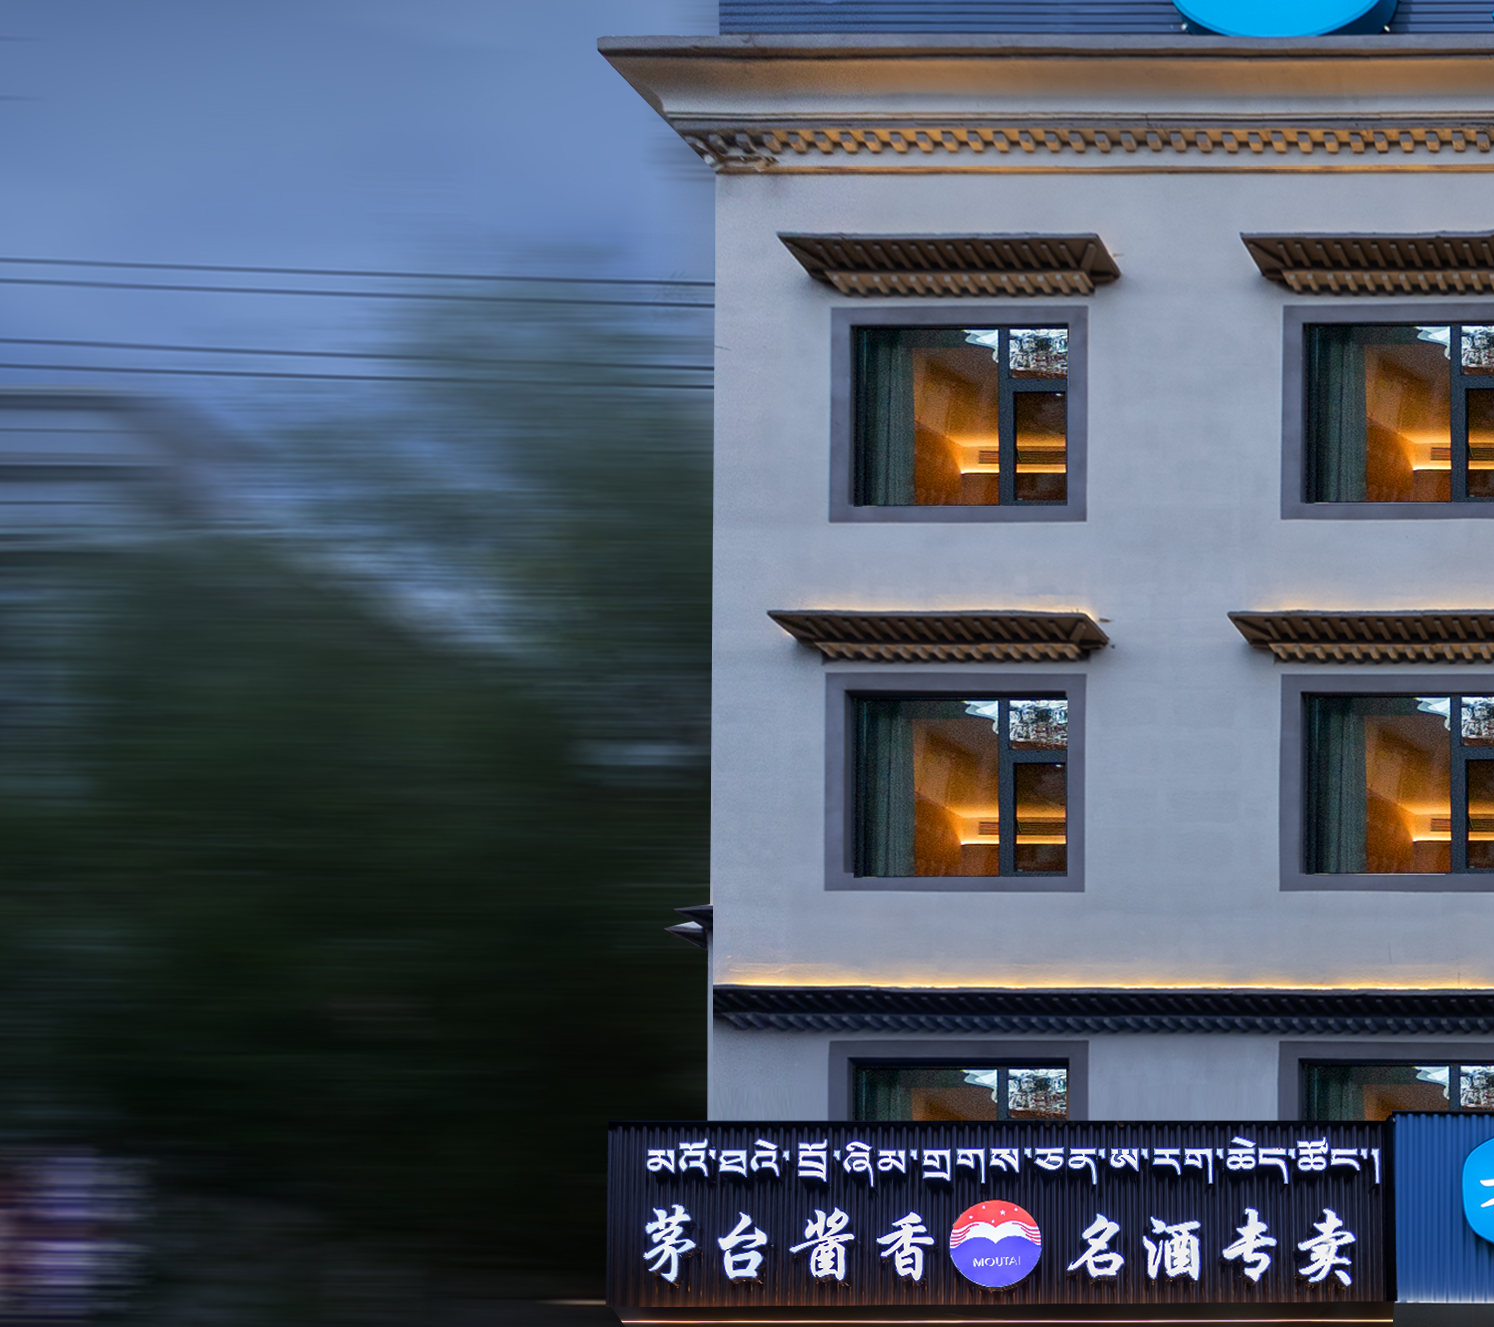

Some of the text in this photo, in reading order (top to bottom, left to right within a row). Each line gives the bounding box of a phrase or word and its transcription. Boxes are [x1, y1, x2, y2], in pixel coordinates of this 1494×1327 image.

[643, 1204, 1357, 1287] 茅台酱香 名酒专卖
[972, 1255, 1022, 1268] MOUTAI
